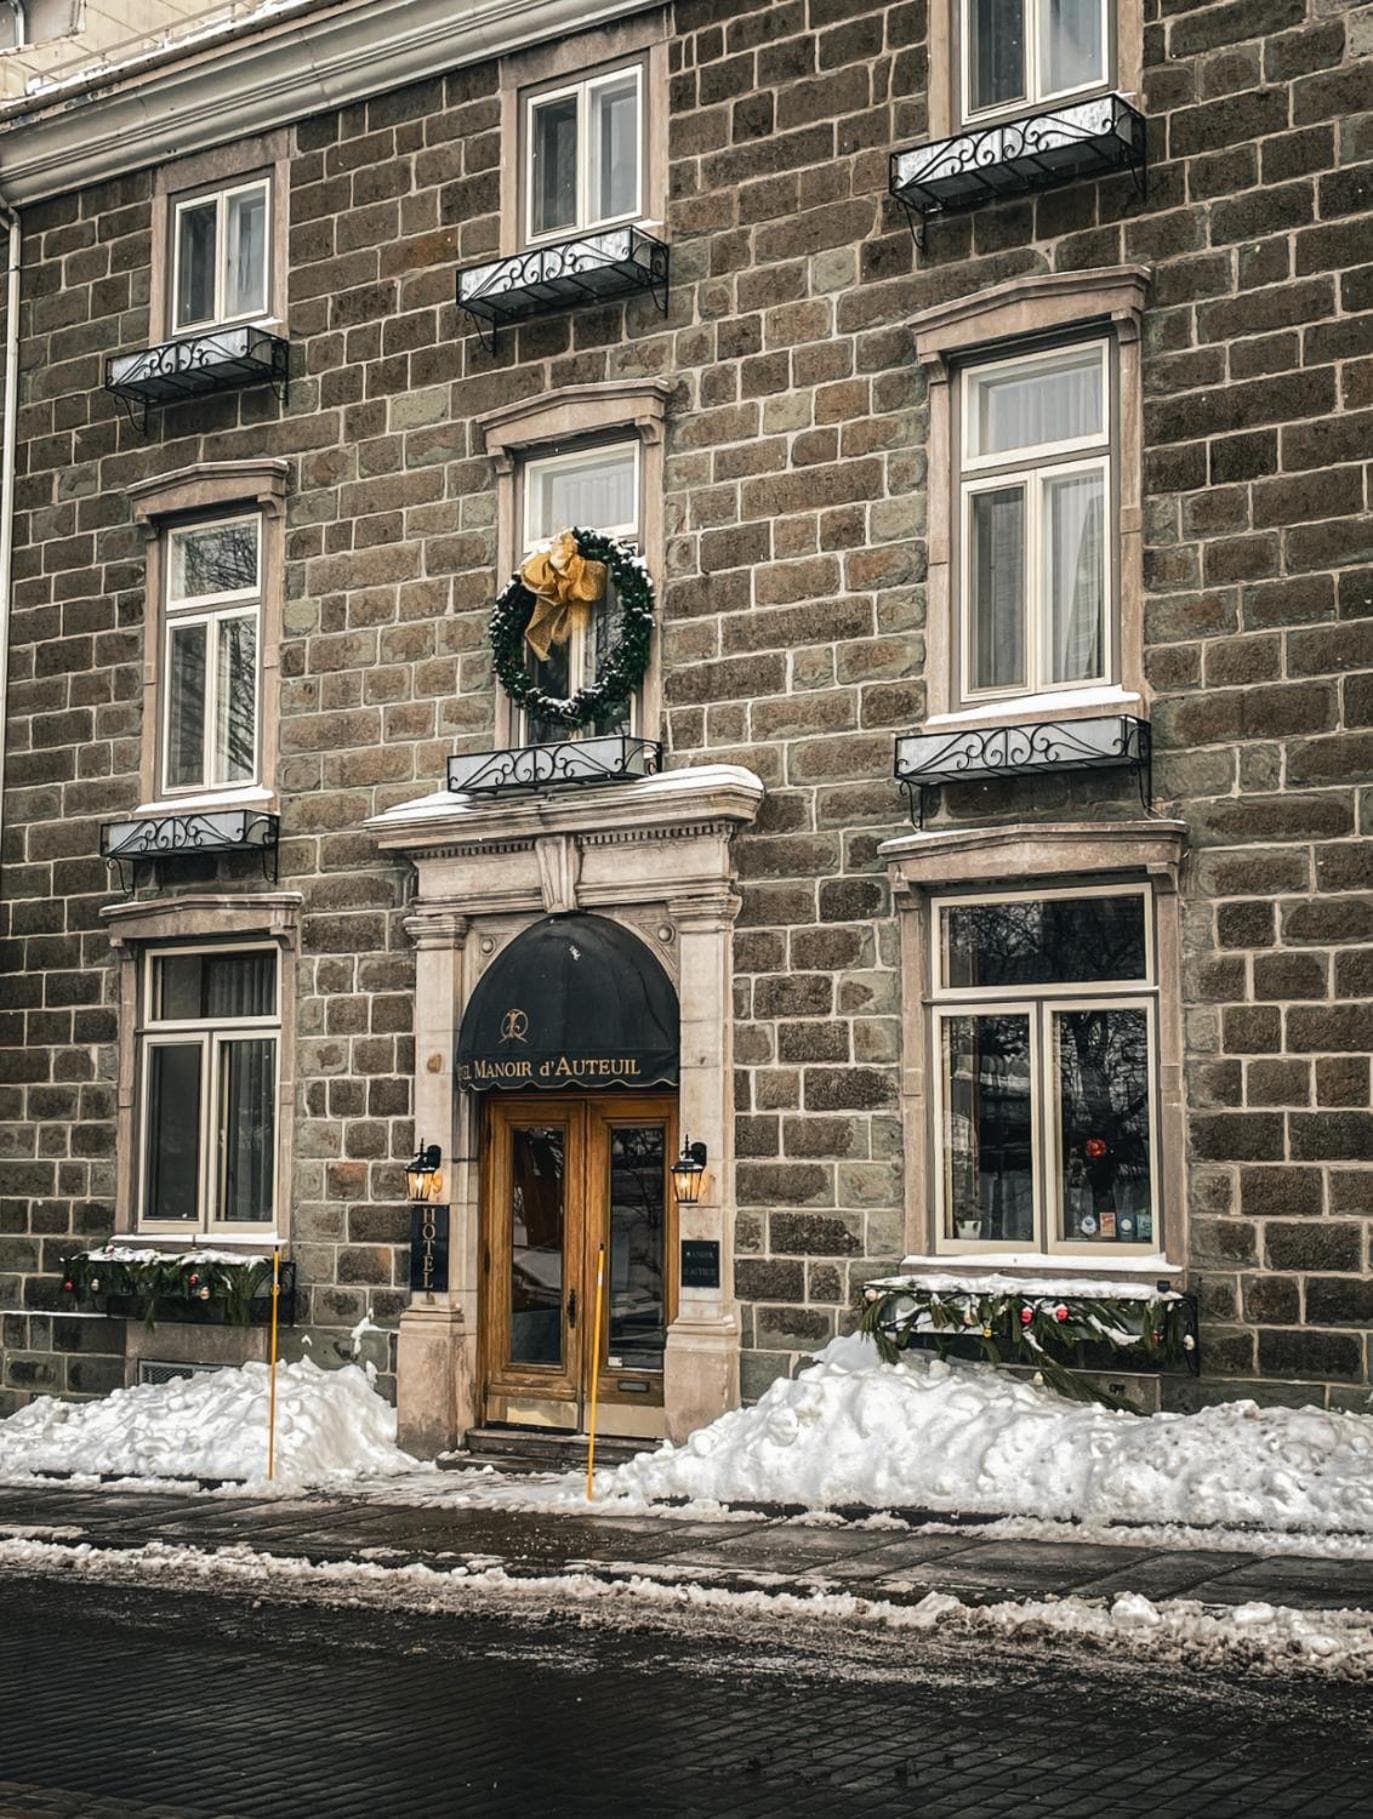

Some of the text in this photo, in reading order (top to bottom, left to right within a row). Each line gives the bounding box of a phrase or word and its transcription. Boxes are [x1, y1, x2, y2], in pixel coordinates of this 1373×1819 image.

[474, 1059, 533, 1079] MANOIR
[539, 1056, 641, 1076] d'AUTEUIL
[422, 1208, 436, 1289] HOTEL
